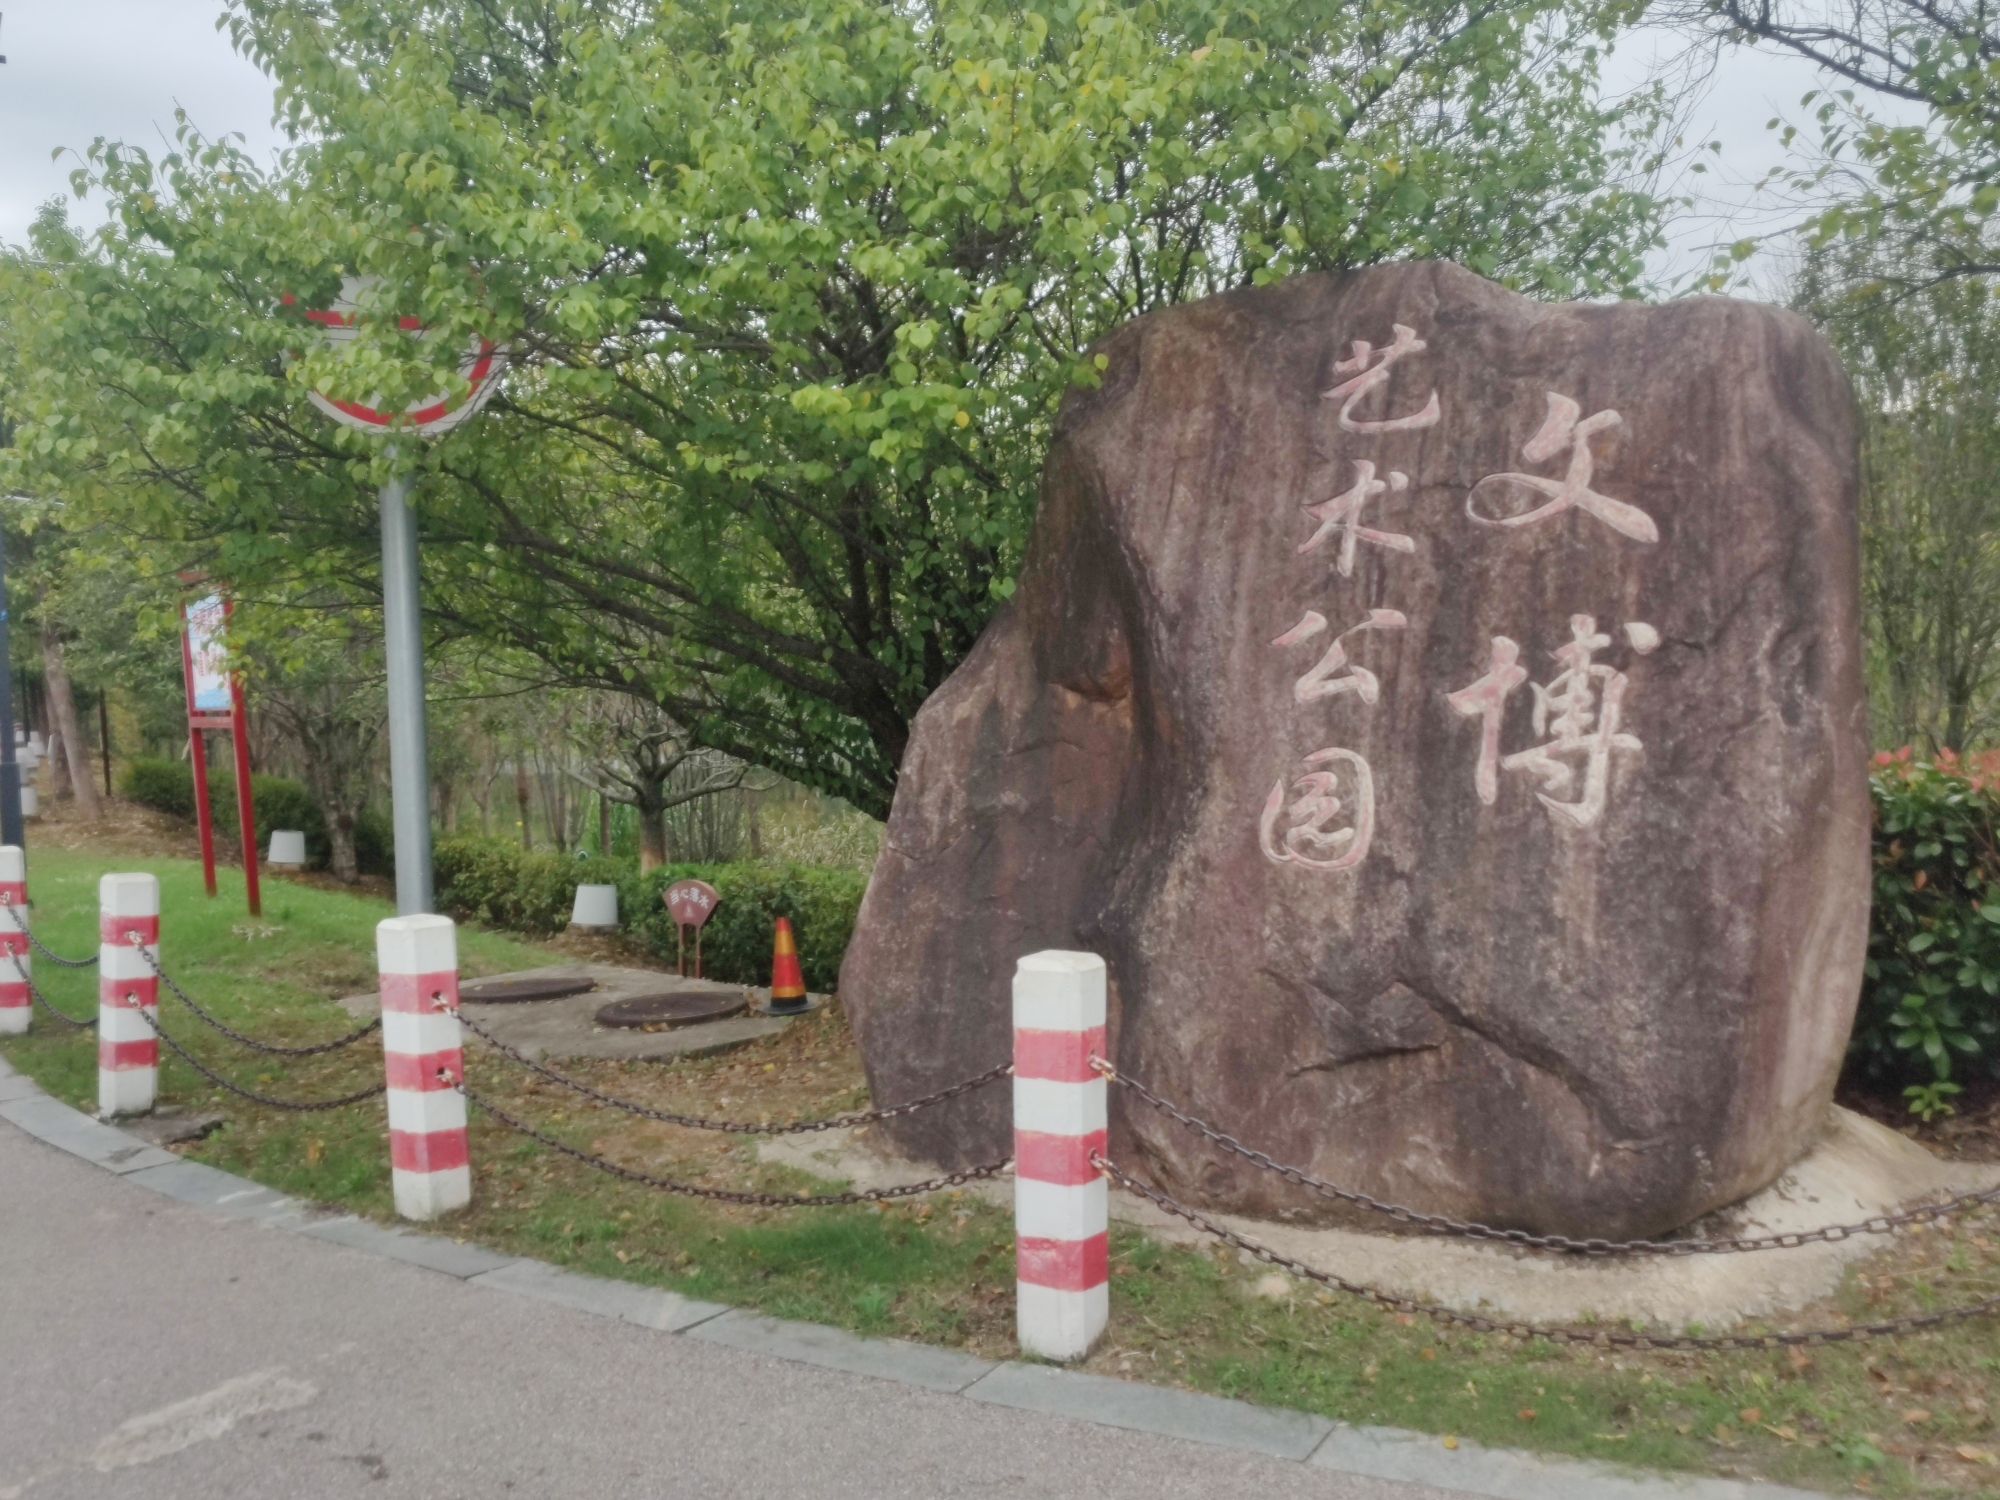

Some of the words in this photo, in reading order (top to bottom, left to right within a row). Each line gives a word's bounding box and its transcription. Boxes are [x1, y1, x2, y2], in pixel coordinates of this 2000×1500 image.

[1260, 323, 1442, 870] 艺术公园
[1448, 391, 1660, 827] 文博
